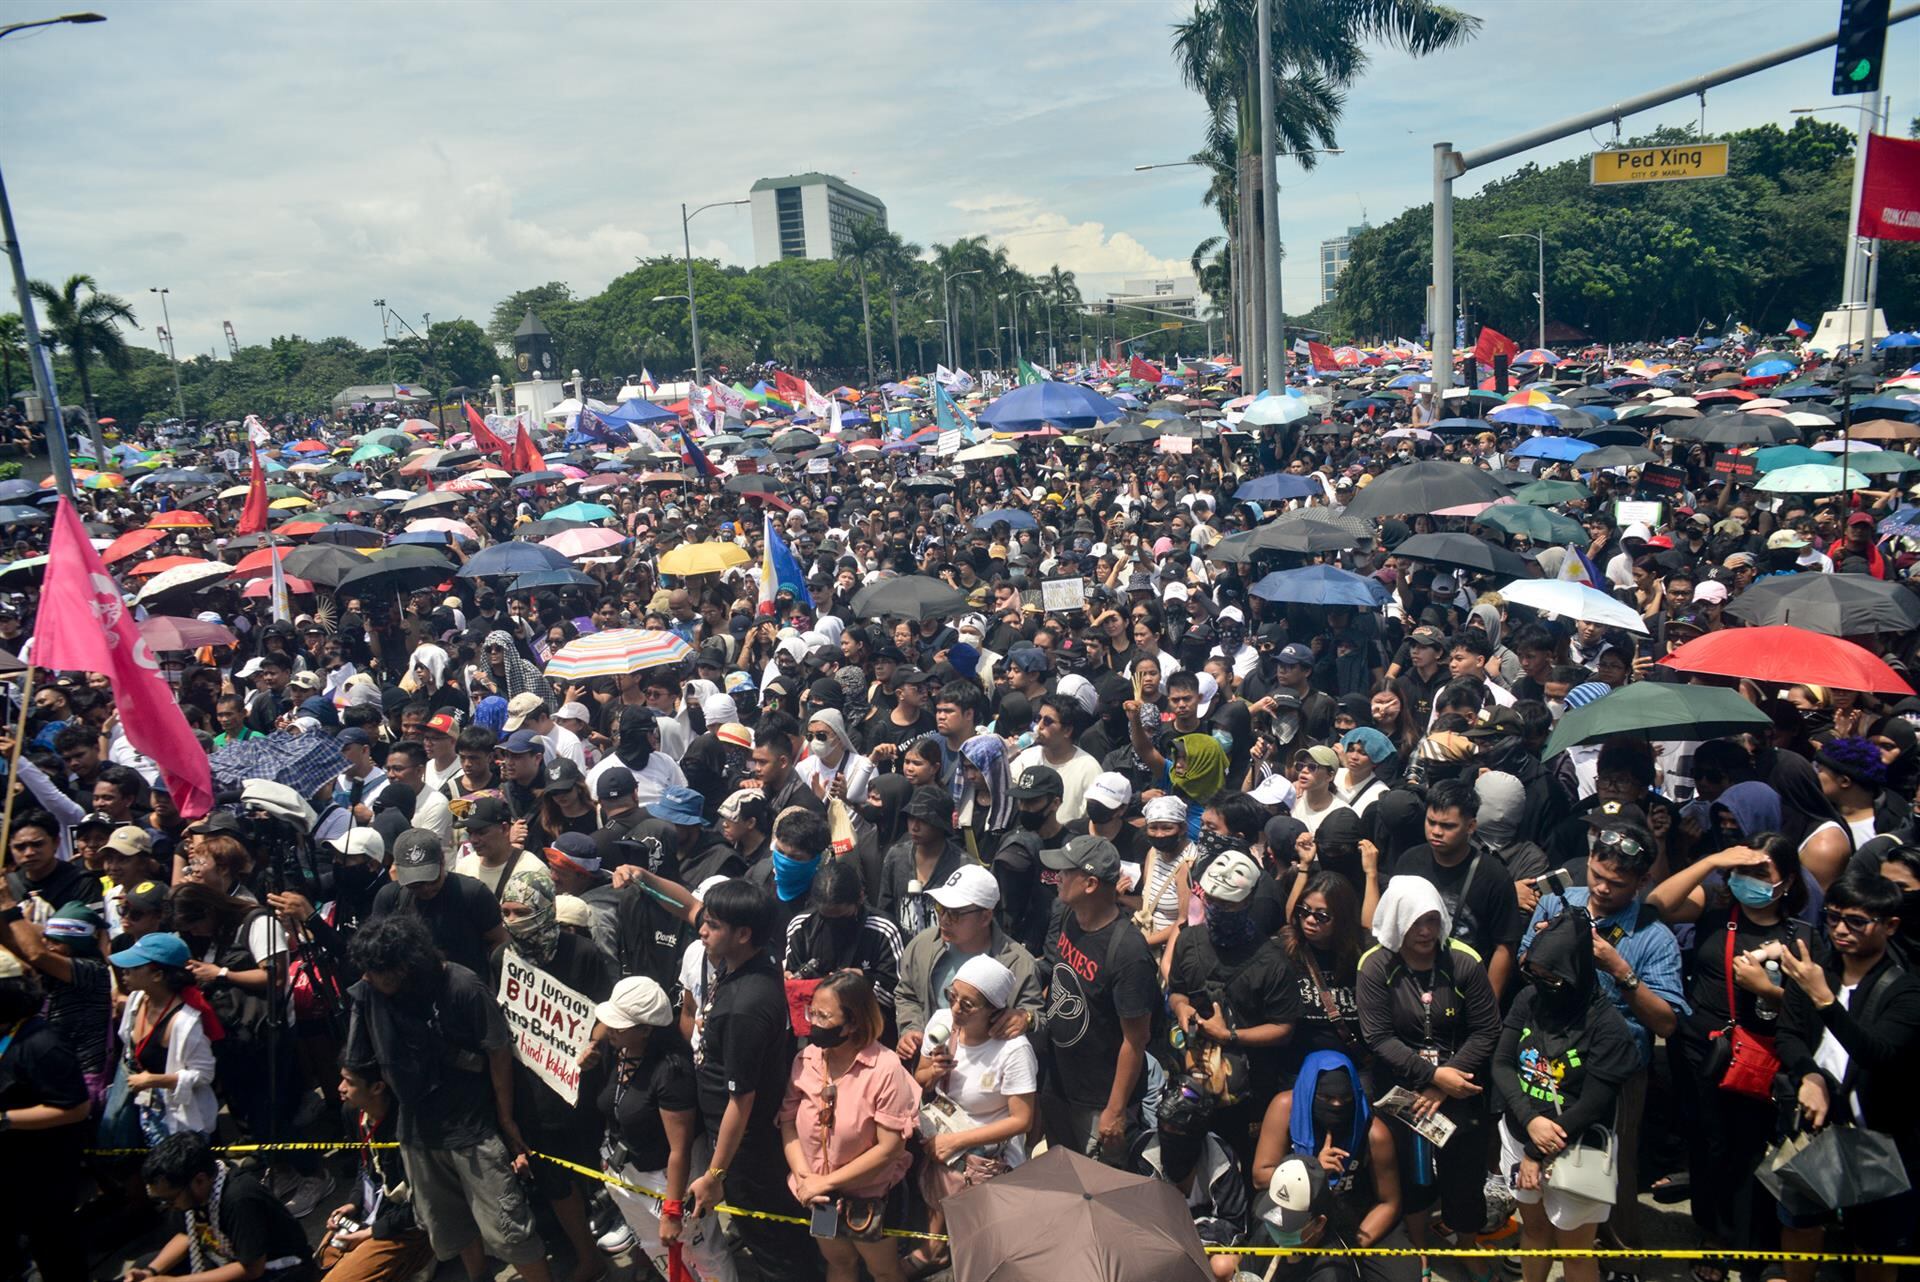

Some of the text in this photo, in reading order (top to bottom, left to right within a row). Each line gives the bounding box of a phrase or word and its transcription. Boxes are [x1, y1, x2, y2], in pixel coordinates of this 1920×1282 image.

[1617, 149, 1702, 169] Ped Xing
[1662, 169, 1687, 177] MANILA
[946, 872, 962, 887] B
[1056, 931, 1099, 982] PIXIES
[507, 962, 535, 988] ang
[519, 1031, 544, 1064] hindi
